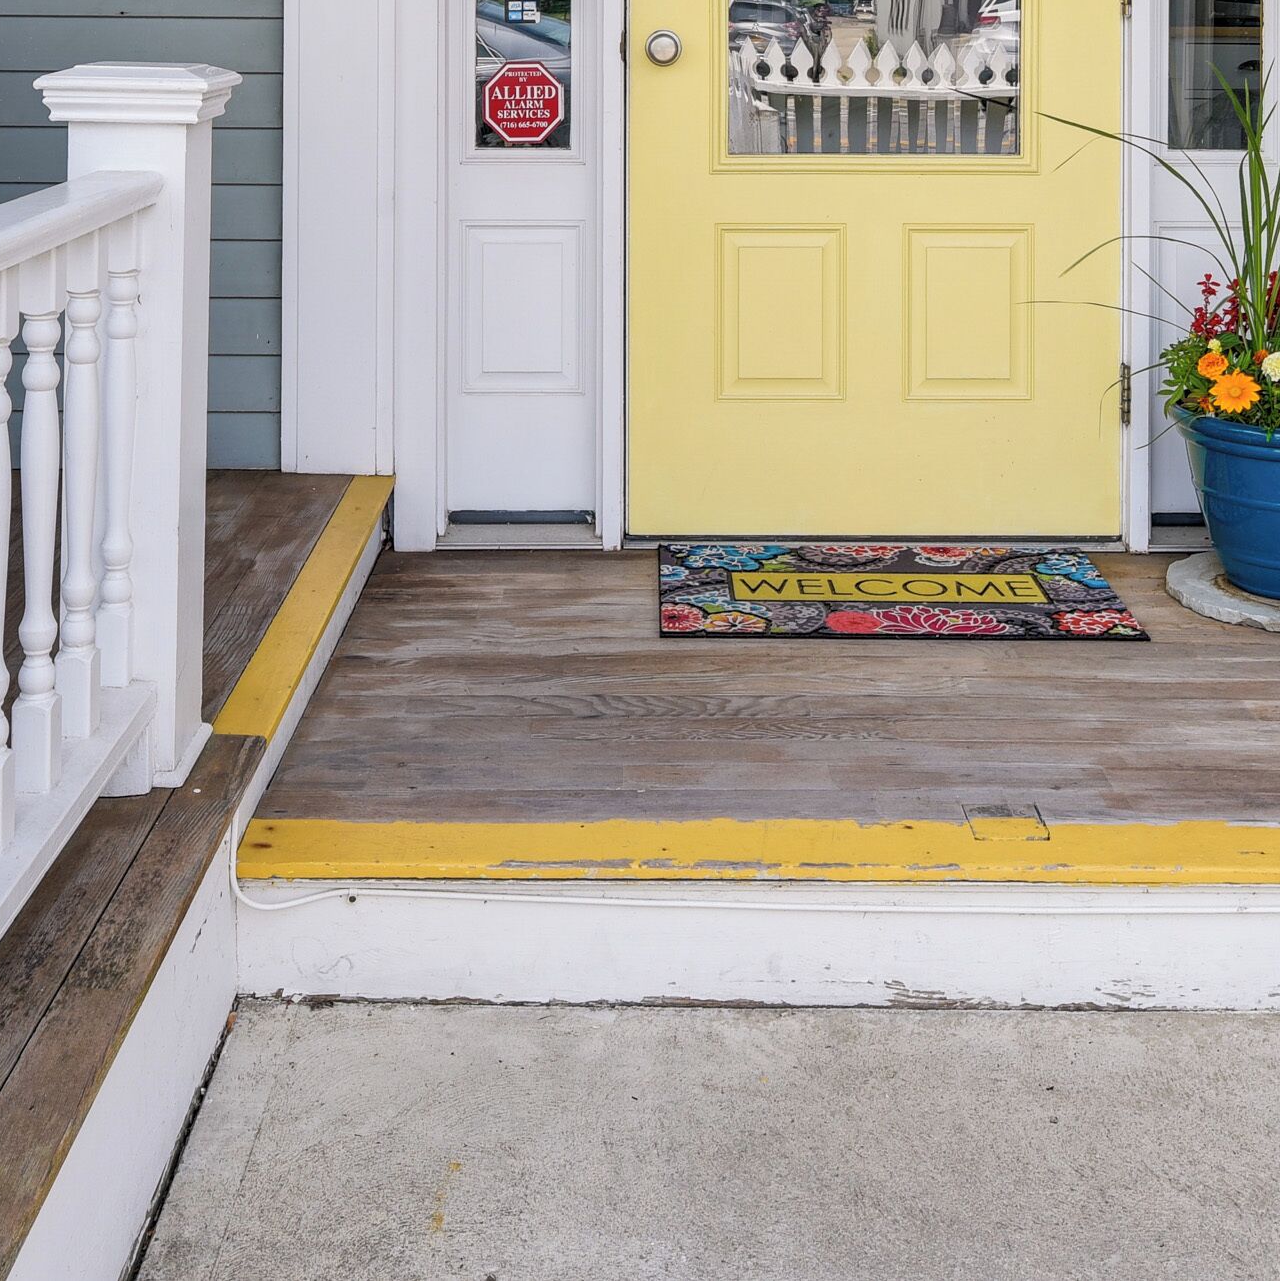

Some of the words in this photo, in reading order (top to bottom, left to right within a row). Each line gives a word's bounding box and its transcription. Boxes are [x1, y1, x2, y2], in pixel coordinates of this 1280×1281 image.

[491, 85, 557, 100] ALLIED
[503, 100, 544, 109] ALARM
[497, 109, 551, 119] SERVICES
[500, 121, 518, 129] (716)
[740, 578, 1038, 598] WELCOME
